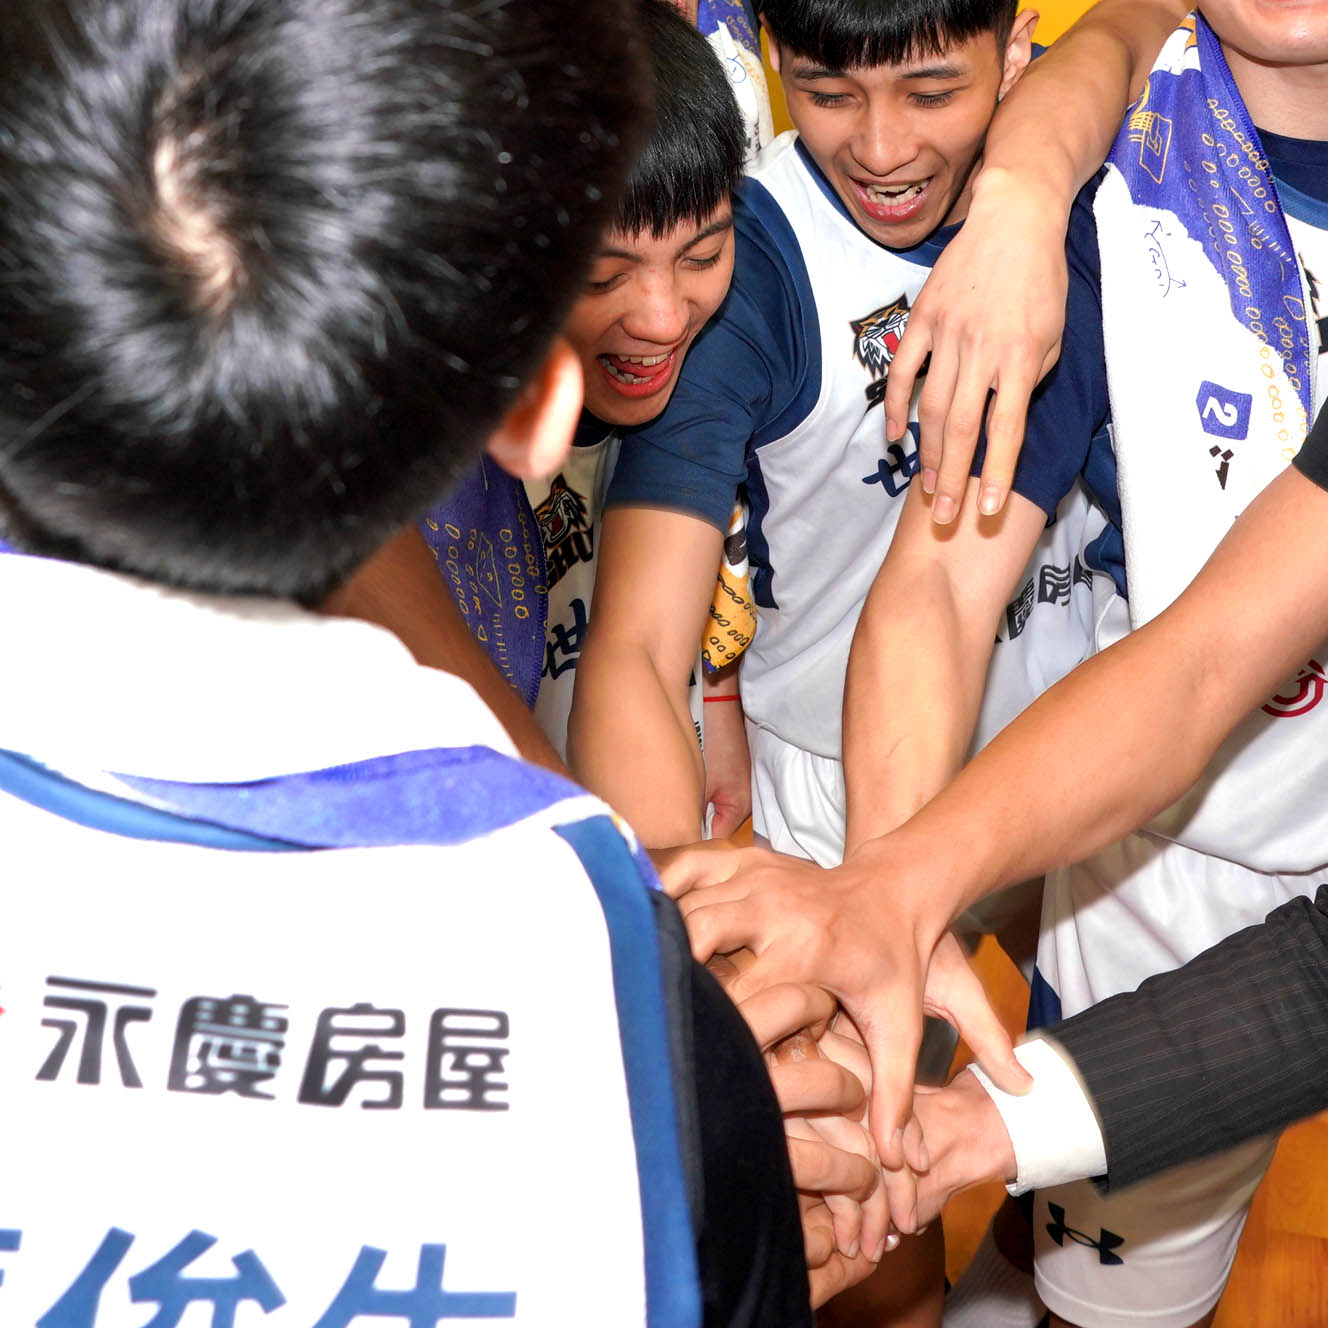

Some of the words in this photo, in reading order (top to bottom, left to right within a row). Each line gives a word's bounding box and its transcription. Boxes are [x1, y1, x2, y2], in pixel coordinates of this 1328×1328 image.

[546, 527, 594, 592] HU
[35, 975, 510, 1112] 永慶房屋
